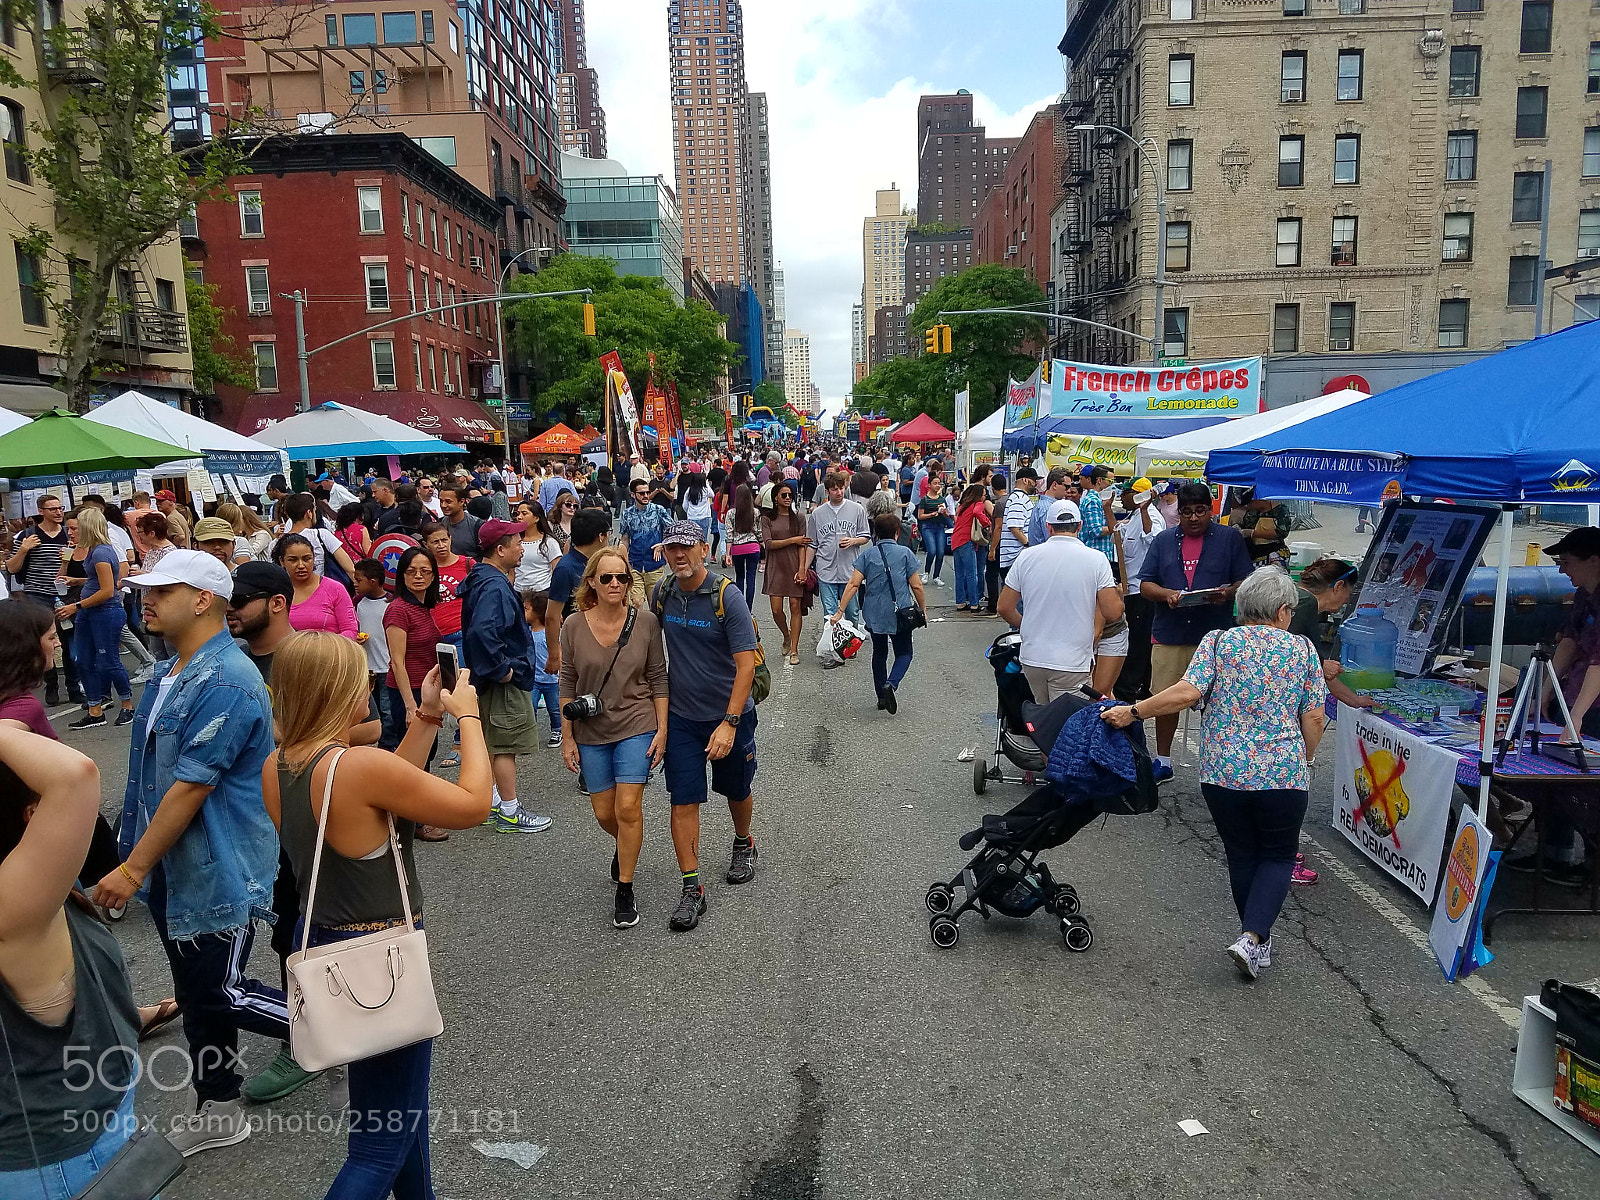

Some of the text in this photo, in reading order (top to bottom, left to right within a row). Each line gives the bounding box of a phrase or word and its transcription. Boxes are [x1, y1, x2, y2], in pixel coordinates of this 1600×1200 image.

[1063, 367, 1249, 393] French Crêpes
[1071, 398, 1134, 413] Très Bon
[1147, 395, 1239, 411] Lemonade
[1262, 455, 1283, 468] THINK
[1284, 456, 1300, 469] YOU
[1300, 457, 1319, 470] LIVE
[1320, 457, 1331, 471] IN
[1330, 458, 1337, 471] A
[1338, 458, 1364, 472] BLUE
[1295, 479, 1353, 496] THINK AGAIN...
[818, 519, 857, 537] NEW YORK
[1355, 720, 1411, 761] trade in the
[1339, 807, 1361, 842] REAL
[1362, 832, 1428, 893] DEMOCRATS
